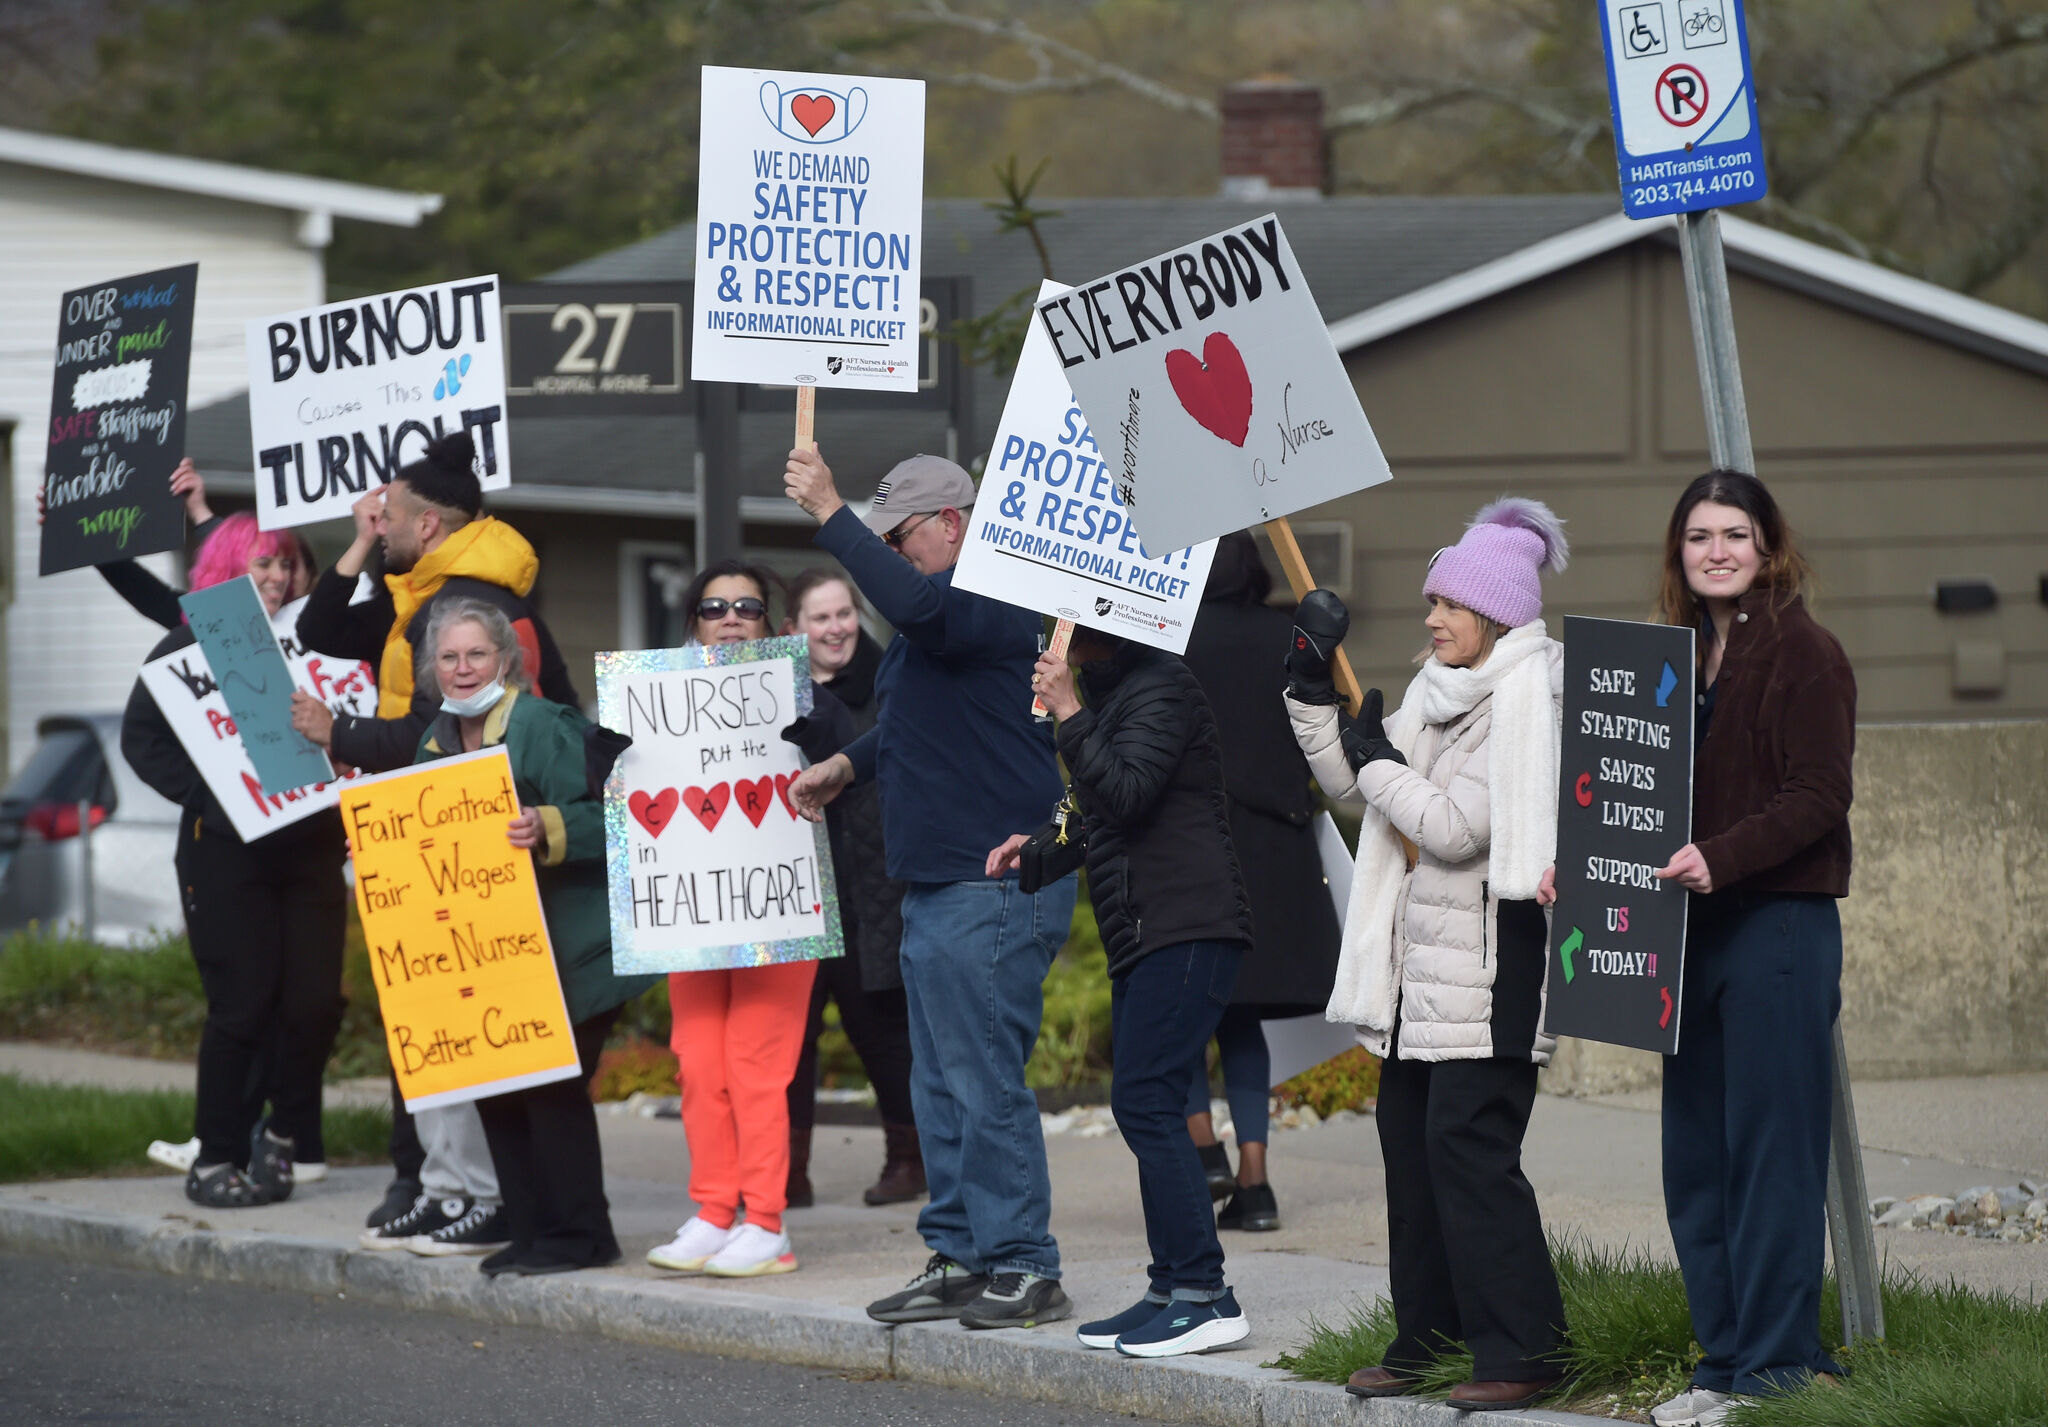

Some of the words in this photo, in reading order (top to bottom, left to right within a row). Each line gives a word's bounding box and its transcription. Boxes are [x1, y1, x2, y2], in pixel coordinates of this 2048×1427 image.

[754, 150, 783, 179] WE
[789, 152, 870, 185] DEMAND
[1630, 151, 1752, 183] HARTransit.com
[1634, 170, 1755, 206] 203.744.4070
[754, 182, 867, 225] SAFETY
[708, 222, 910, 271] PROTECTION
[67, 288, 118, 326] OVER
[717, 265, 742, 303] &
[754, 268, 900, 312] RESPECT!
[1039, 219, 1291, 368] EVERYBODY
[55, 331, 113, 367] UNDER
[116, 318, 172, 363] paid
[268, 281, 494, 382] BURNOUT
[551, 303, 635, 373] 27
[707, 310, 845, 337] INFORMATIONAL
[850, 318, 906, 340] PICKET
[846, 364, 887, 373] Professionals
[860, 358, 881, 366] Nurses
[51, 411, 97, 445] SAFE
[97, 400, 177, 446] staffing
[298, 396, 362, 425] Causes
[377, 382, 422, 406] This
[1277, 382, 1334, 465] Nurse
[1118, 387, 1142, 507] #worthmore
[999, 434, 1124, 507] PROTE
[77, 506, 146, 550] wage
[999, 480, 1027, 522] &
[1036, 491, 1193, 570] RESPE!
[980, 520, 1124, 581] INFORMATIONAL
[1127, 564, 1190, 600] PICKET
[1114, 609, 1157, 628] Professionals
[1115, 603, 1130, 612] AFT
[1130, 607, 1152, 619] Nurses
[1159, 615, 1182, 628] Health
[1590, 668, 1636, 696] SAFE
[627, 671, 778, 737] NURSES
[1581, 710, 1671, 750] STAFFING
[700, 743, 731, 773] put
[740, 740, 768, 759] the
[1600, 757, 1655, 791] SAVES
[351, 802, 414, 851] Fair
[418, 776, 516, 829] Contract
[645, 786, 789, 825] CAR
[1602, 801, 1664, 833] LIVES!!
[638, 843, 657, 865] in
[1586, 855, 1663, 892] SUPPORT
[360, 872, 411, 914] Fair
[420, 841, 517, 899] Wages
[631, 856, 821, 929] HEALTHCARE!
[1606, 906, 1629, 932] US
[377, 939, 453, 987] More
[449, 921, 544, 972] Nurses
[1588, 949, 1658, 978] TODAY!!
[392, 1023, 478, 1077] Better
[482, 1005, 554, 1050] Care
